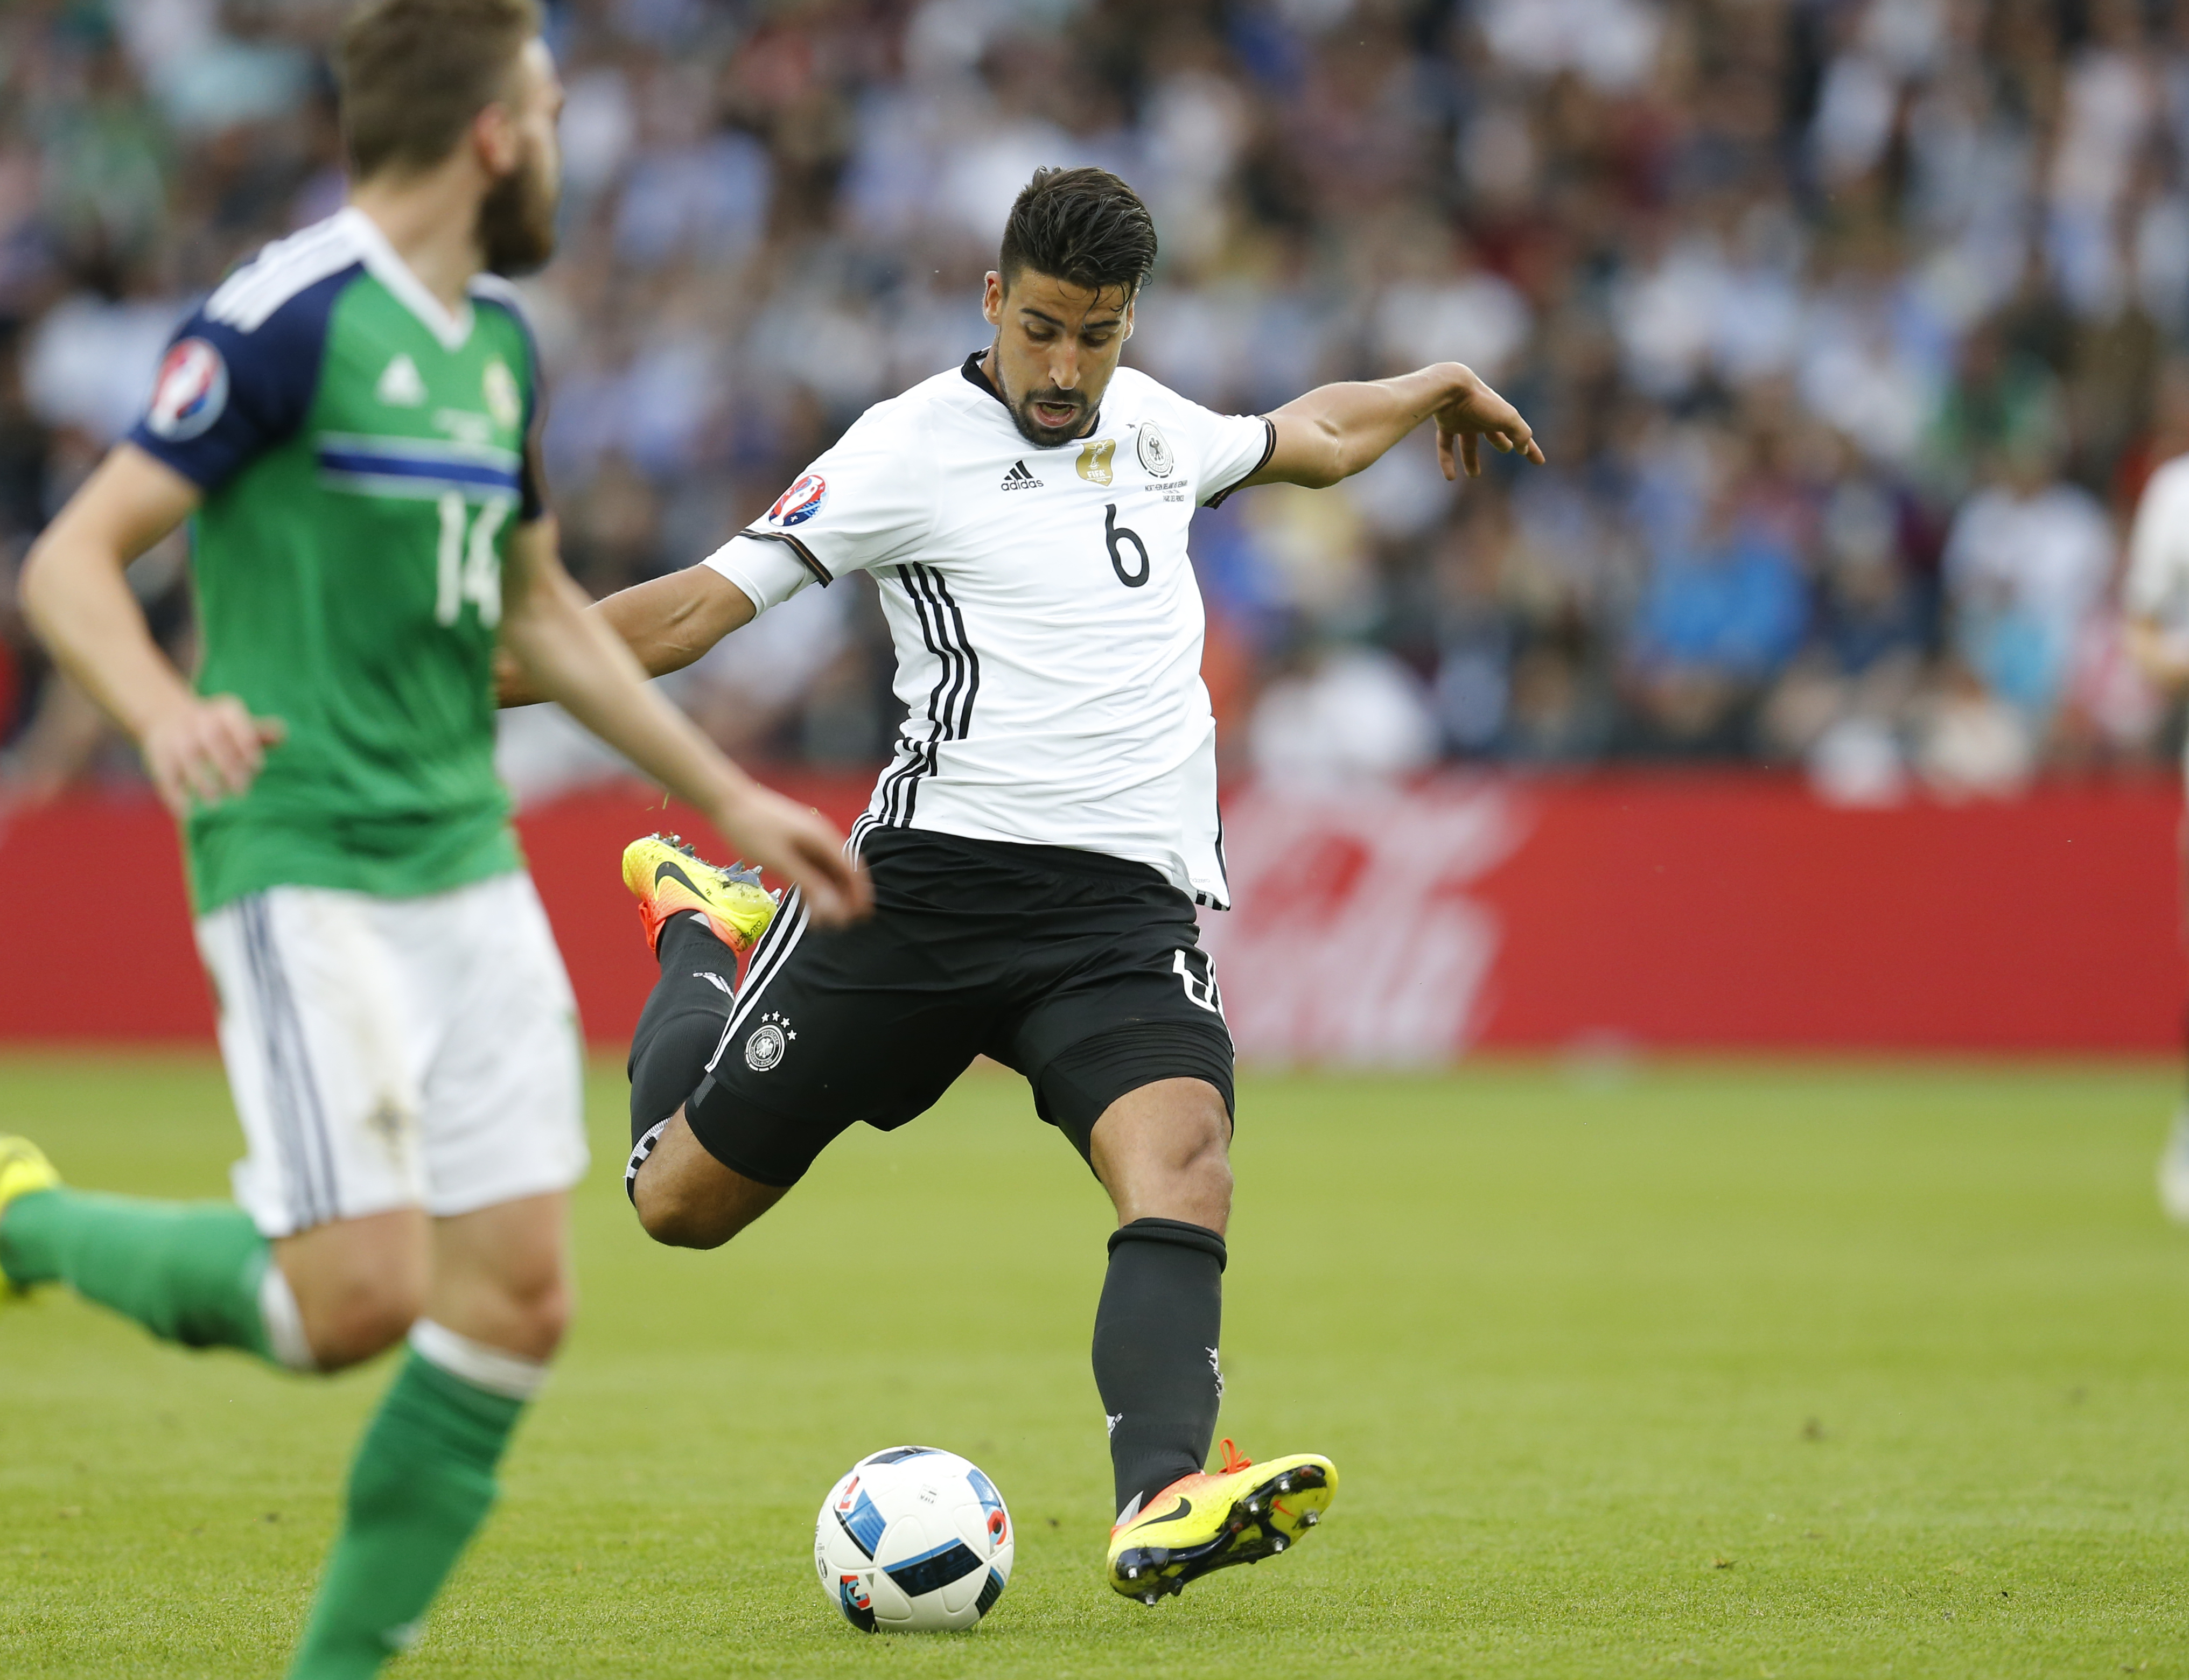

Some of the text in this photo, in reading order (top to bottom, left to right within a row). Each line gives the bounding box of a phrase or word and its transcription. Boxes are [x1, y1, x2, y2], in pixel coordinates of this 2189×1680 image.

[1001, 479, 1044, 491] adidas
[1087, 469, 1106, 478] FIFA
[436, 489, 506, 628] 14
[1106, 503, 1150, 587] 6
